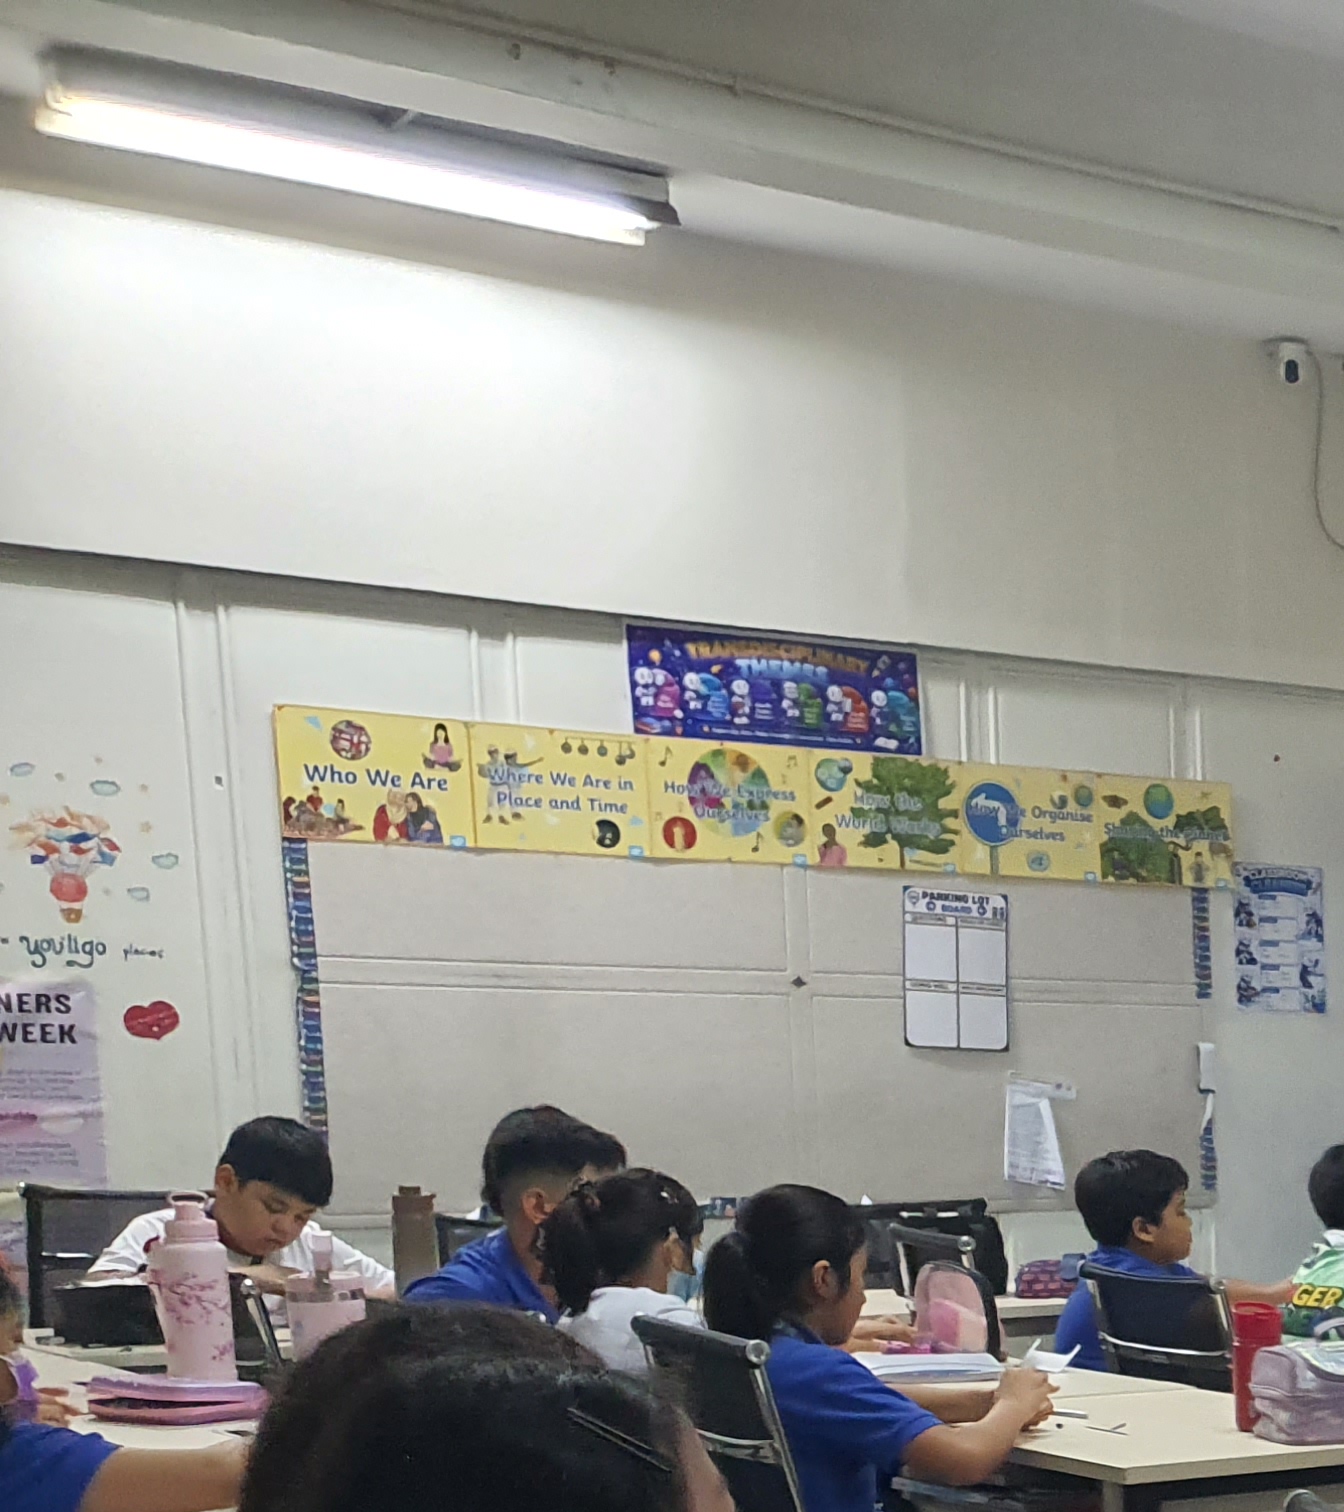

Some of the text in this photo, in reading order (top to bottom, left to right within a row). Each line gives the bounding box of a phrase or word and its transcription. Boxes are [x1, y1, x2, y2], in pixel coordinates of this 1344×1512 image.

[735, 658, 829, 682] THEMES
[303, 764, 448, 791] Who We Are
[488, 767, 634, 791] Where We Are in
[663, 780, 796, 802] How We Express
[496, 791, 628, 815] Place and Time
[694, 804, 771, 821] Ourselves
[969, 803, 1000, 817] How
[1031, 806, 1094, 824] Organise
[835, 814, 886, 831] World
[1161, 827, 1177, 839] the
[1000, 826, 1065, 841] Ourselves
[972, 896, 990, 906] LOT
[1292, 1284, 1343, 1308] GER
